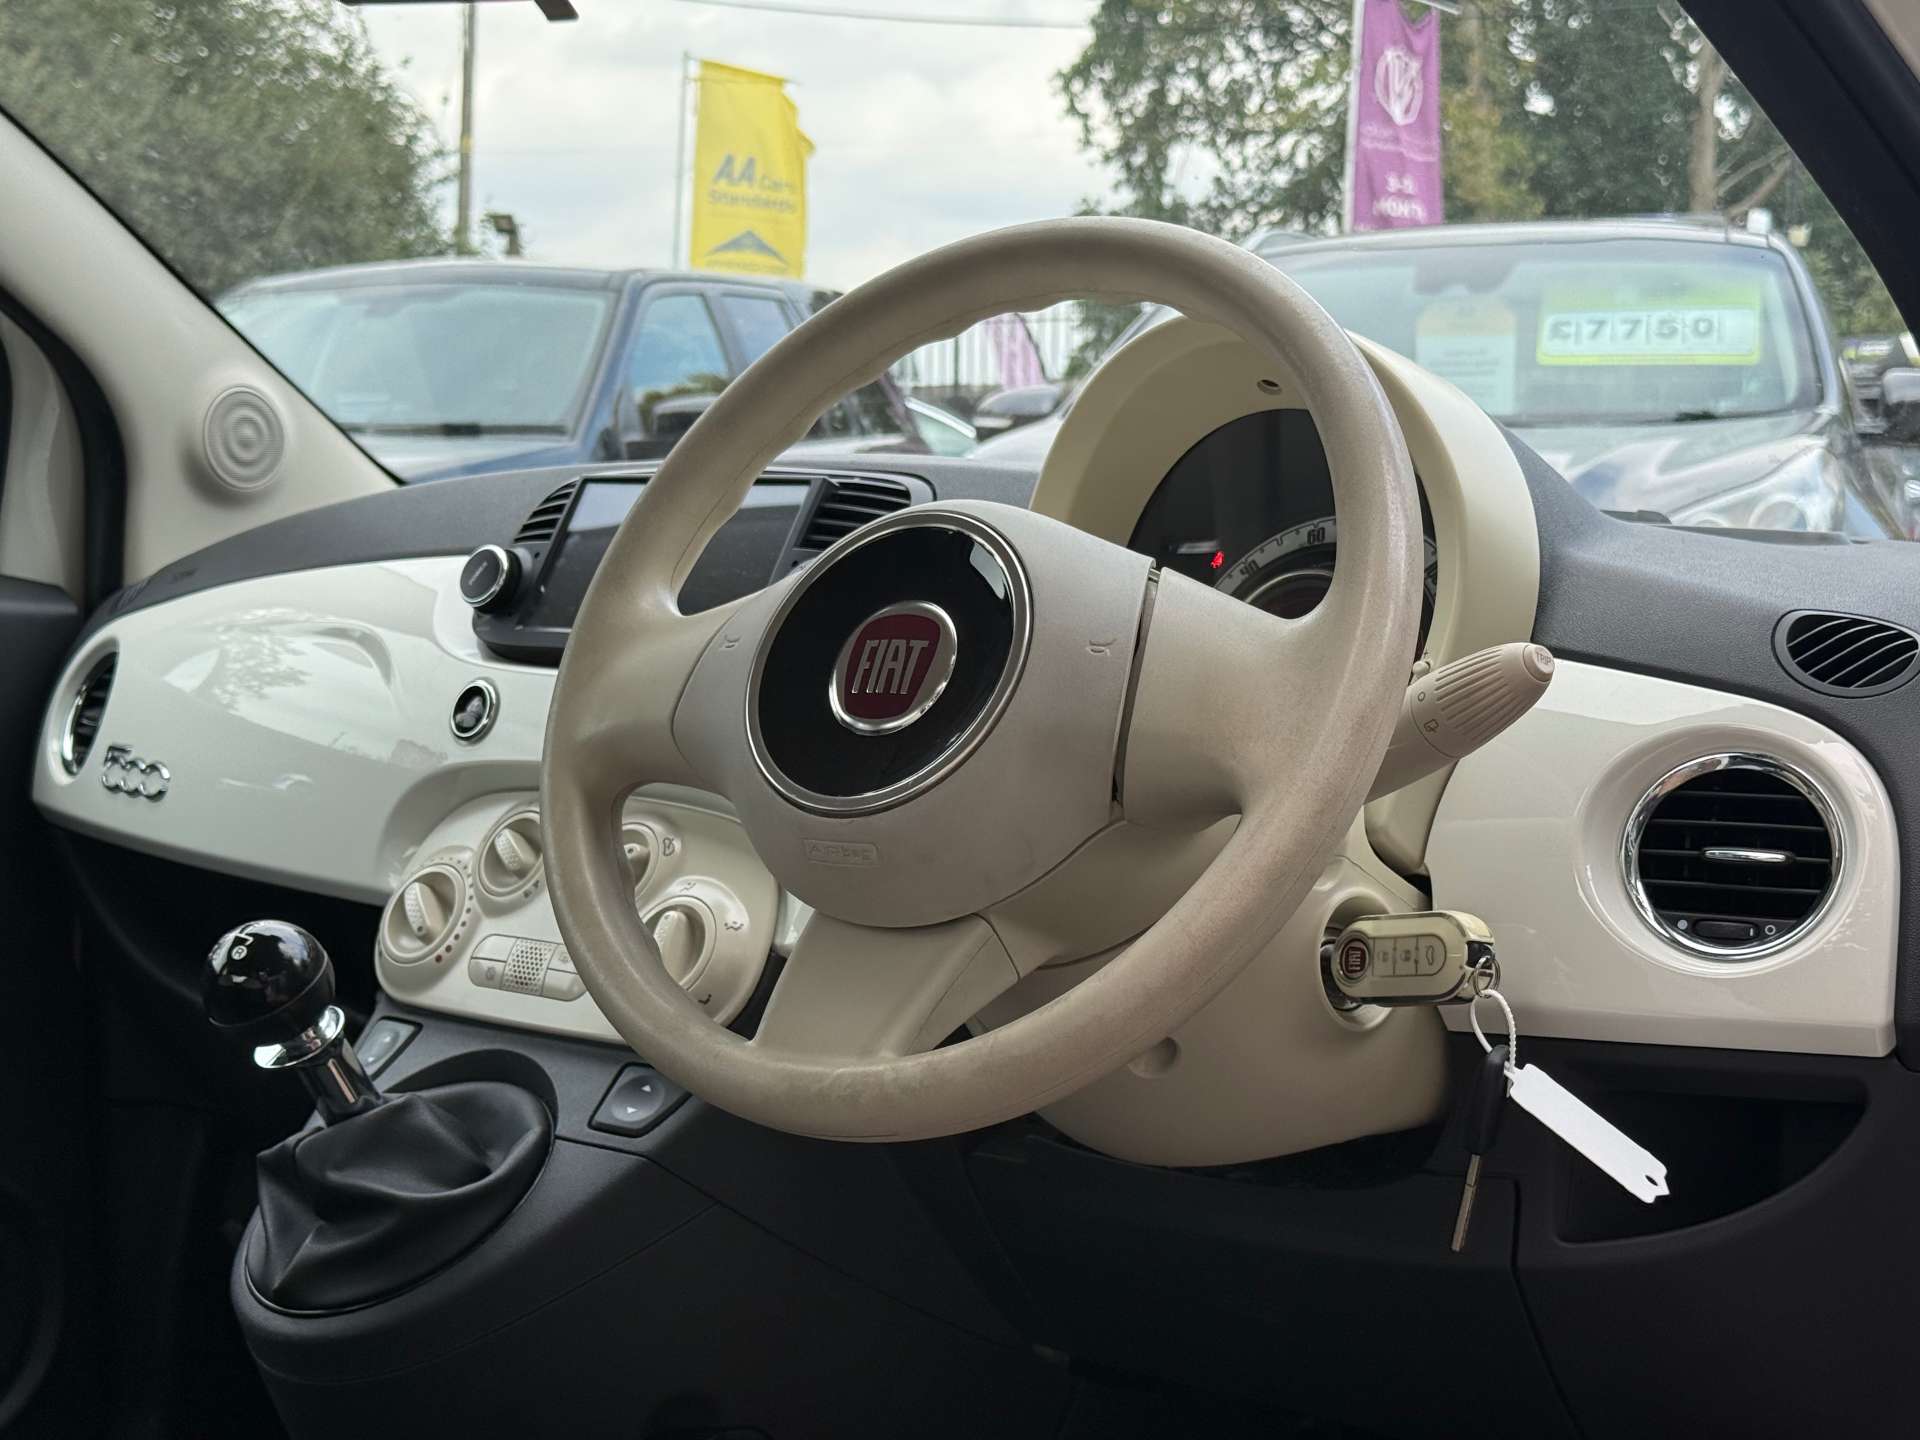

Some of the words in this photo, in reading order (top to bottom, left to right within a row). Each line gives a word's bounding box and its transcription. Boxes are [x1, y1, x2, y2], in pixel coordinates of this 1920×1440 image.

[713, 153, 756, 187] AA
[1306, 527, 1325, 545] 60
[851, 639, 930, 694] FIAT
[1535, 650, 1552, 666] TRIP
[102, 744, 171, 803] 500
